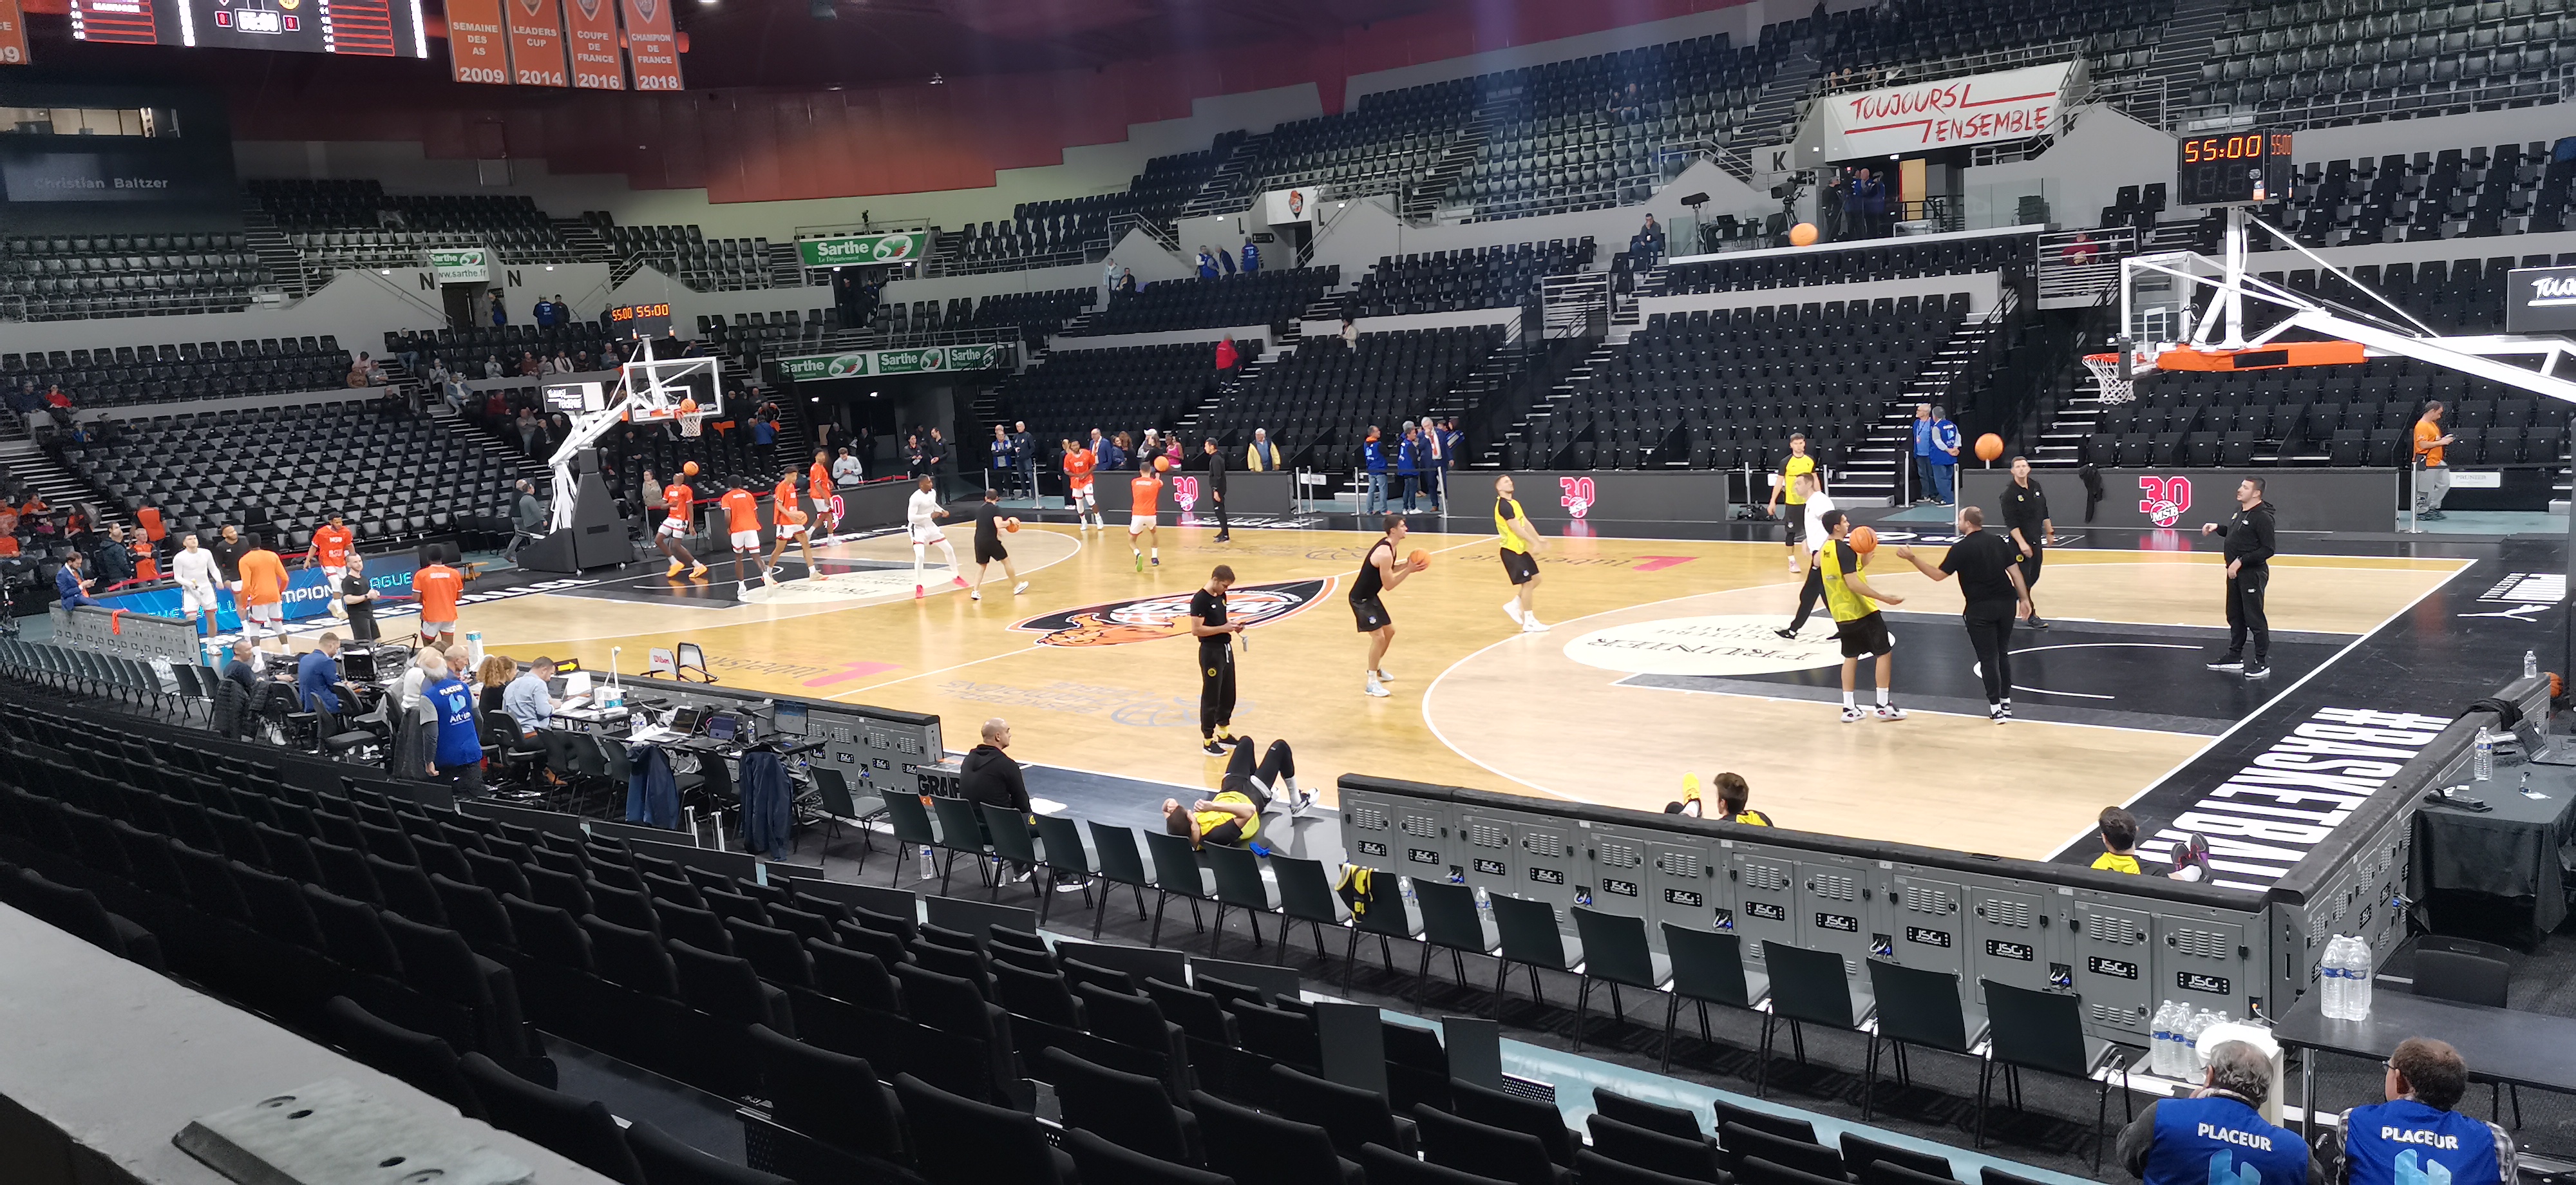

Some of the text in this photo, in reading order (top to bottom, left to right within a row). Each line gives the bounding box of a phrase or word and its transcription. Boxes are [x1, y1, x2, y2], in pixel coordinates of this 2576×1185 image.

[453, 22, 498, 33] SEMAINE
[513, 26, 557, 37] LEADERS
[468, 35, 488, 44] DES
[527, 38, 547, 47] CUP
[577, 31, 609, 41] COUPE
[631, 33, 671, 42] CHAMPION
[472, 47, 486, 55] AS
[589, 42, 601, 51] DE
[647, 44, 659, 53] DE
[577, 53, 614, 64] FRANCE
[638, 55, 672, 64] FRANCE
[459, 67, 505, 83] 2009
[519, 70, 563, 86] 2014
[578, 73, 620, 89] 2016
[640, 75, 678, 89] 2018
[1849, 82, 1960, 121] TOUJOURS
[1934, 106, 2049, 143] ENSEMBLE
[2185, 135, 2262, 162] 55:00
[2270, 134, 2293, 155] 55:00
[1772, 151, 1787, 171] K
[113, 178, 168, 188] Baltzer
[1318, 208, 1325, 226] L
[1238, 218, 1245, 234] L
[817, 240, 869, 256] Sarthe
[438, 267, 486, 278] ww.sarthe.fr
[507, 270, 522, 287] N
[419, 273, 435, 290] N
[612, 307, 632, 321] 55:00
[636, 304, 669, 318] 55:00
[881, 353, 918, 366] Sarthe
[951, 348, 981, 361] Sarthe
[1172, 475, 1198, 502] 30
[1559, 477, 1595, 507] 30
[2139, 476, 2192, 513] 30
[2151, 506, 2180, 523] MSB
[369, 572, 412, 589] AGUE
[281, 584, 334, 604] MPION
[1587, 638, 1820, 661] PRUNIER
[653, 654, 670, 665] Wilson
[2136, 707, 2454, 893] #BASKETBAL
[1996, 943, 2023, 956] JSG
[2099, 960, 2127, 973] JSG
[2188, 975, 2219, 988] JSG
[2197, 1122, 2273, 1152] PLACEUR
[2380, 1126, 2459, 1150] PLACEUR
